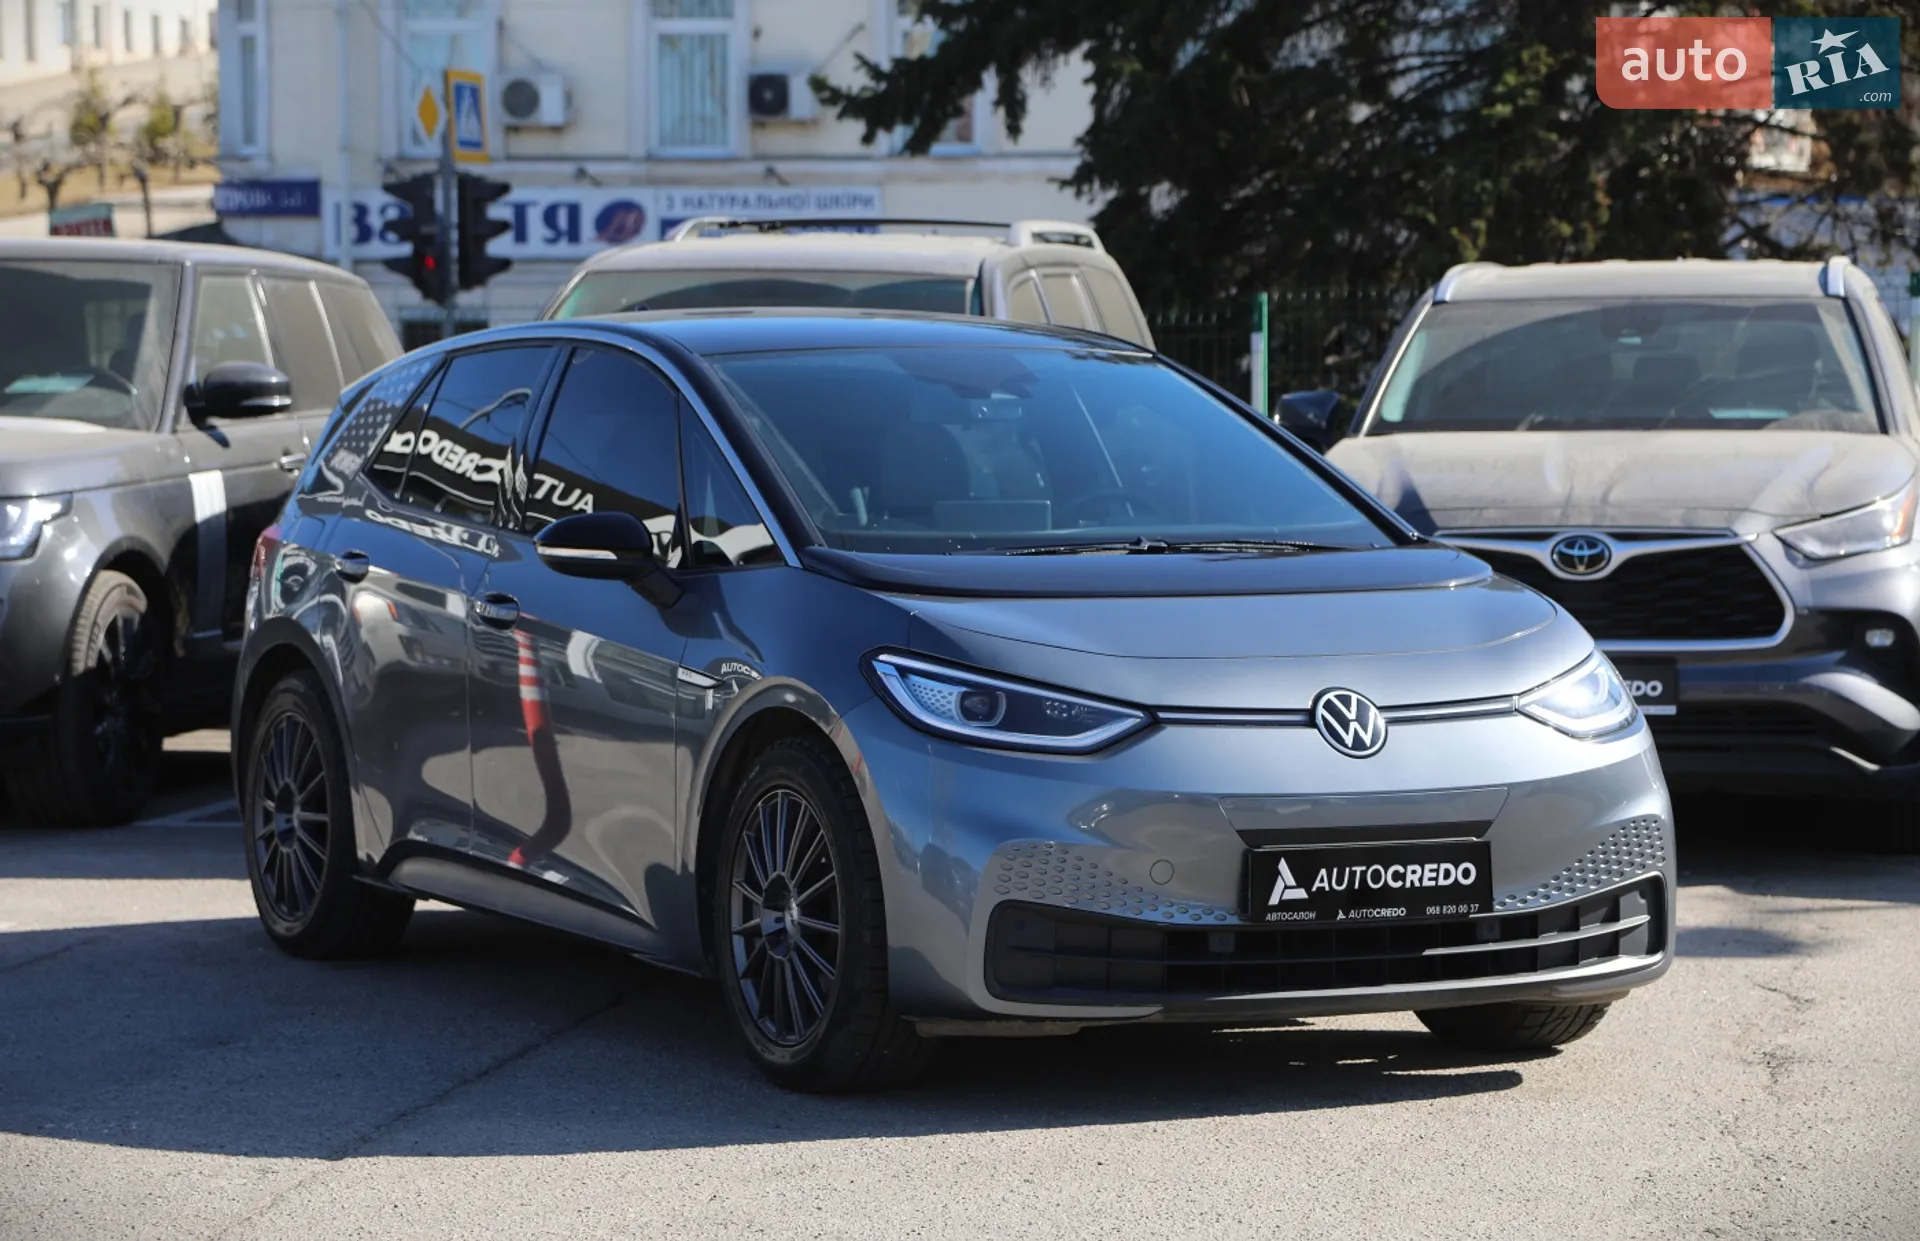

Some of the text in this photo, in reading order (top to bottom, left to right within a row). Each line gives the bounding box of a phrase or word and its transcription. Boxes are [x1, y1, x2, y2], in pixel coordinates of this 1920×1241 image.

[1311, 862, 1477, 892] AUTOCREDO
[1348, 907, 1407, 919] AUTOCREDO
[1426, 905, 1441, 915] 068
[1458, 904, 1468, 914] 00
[1469, 903, 1480, 913] 37
